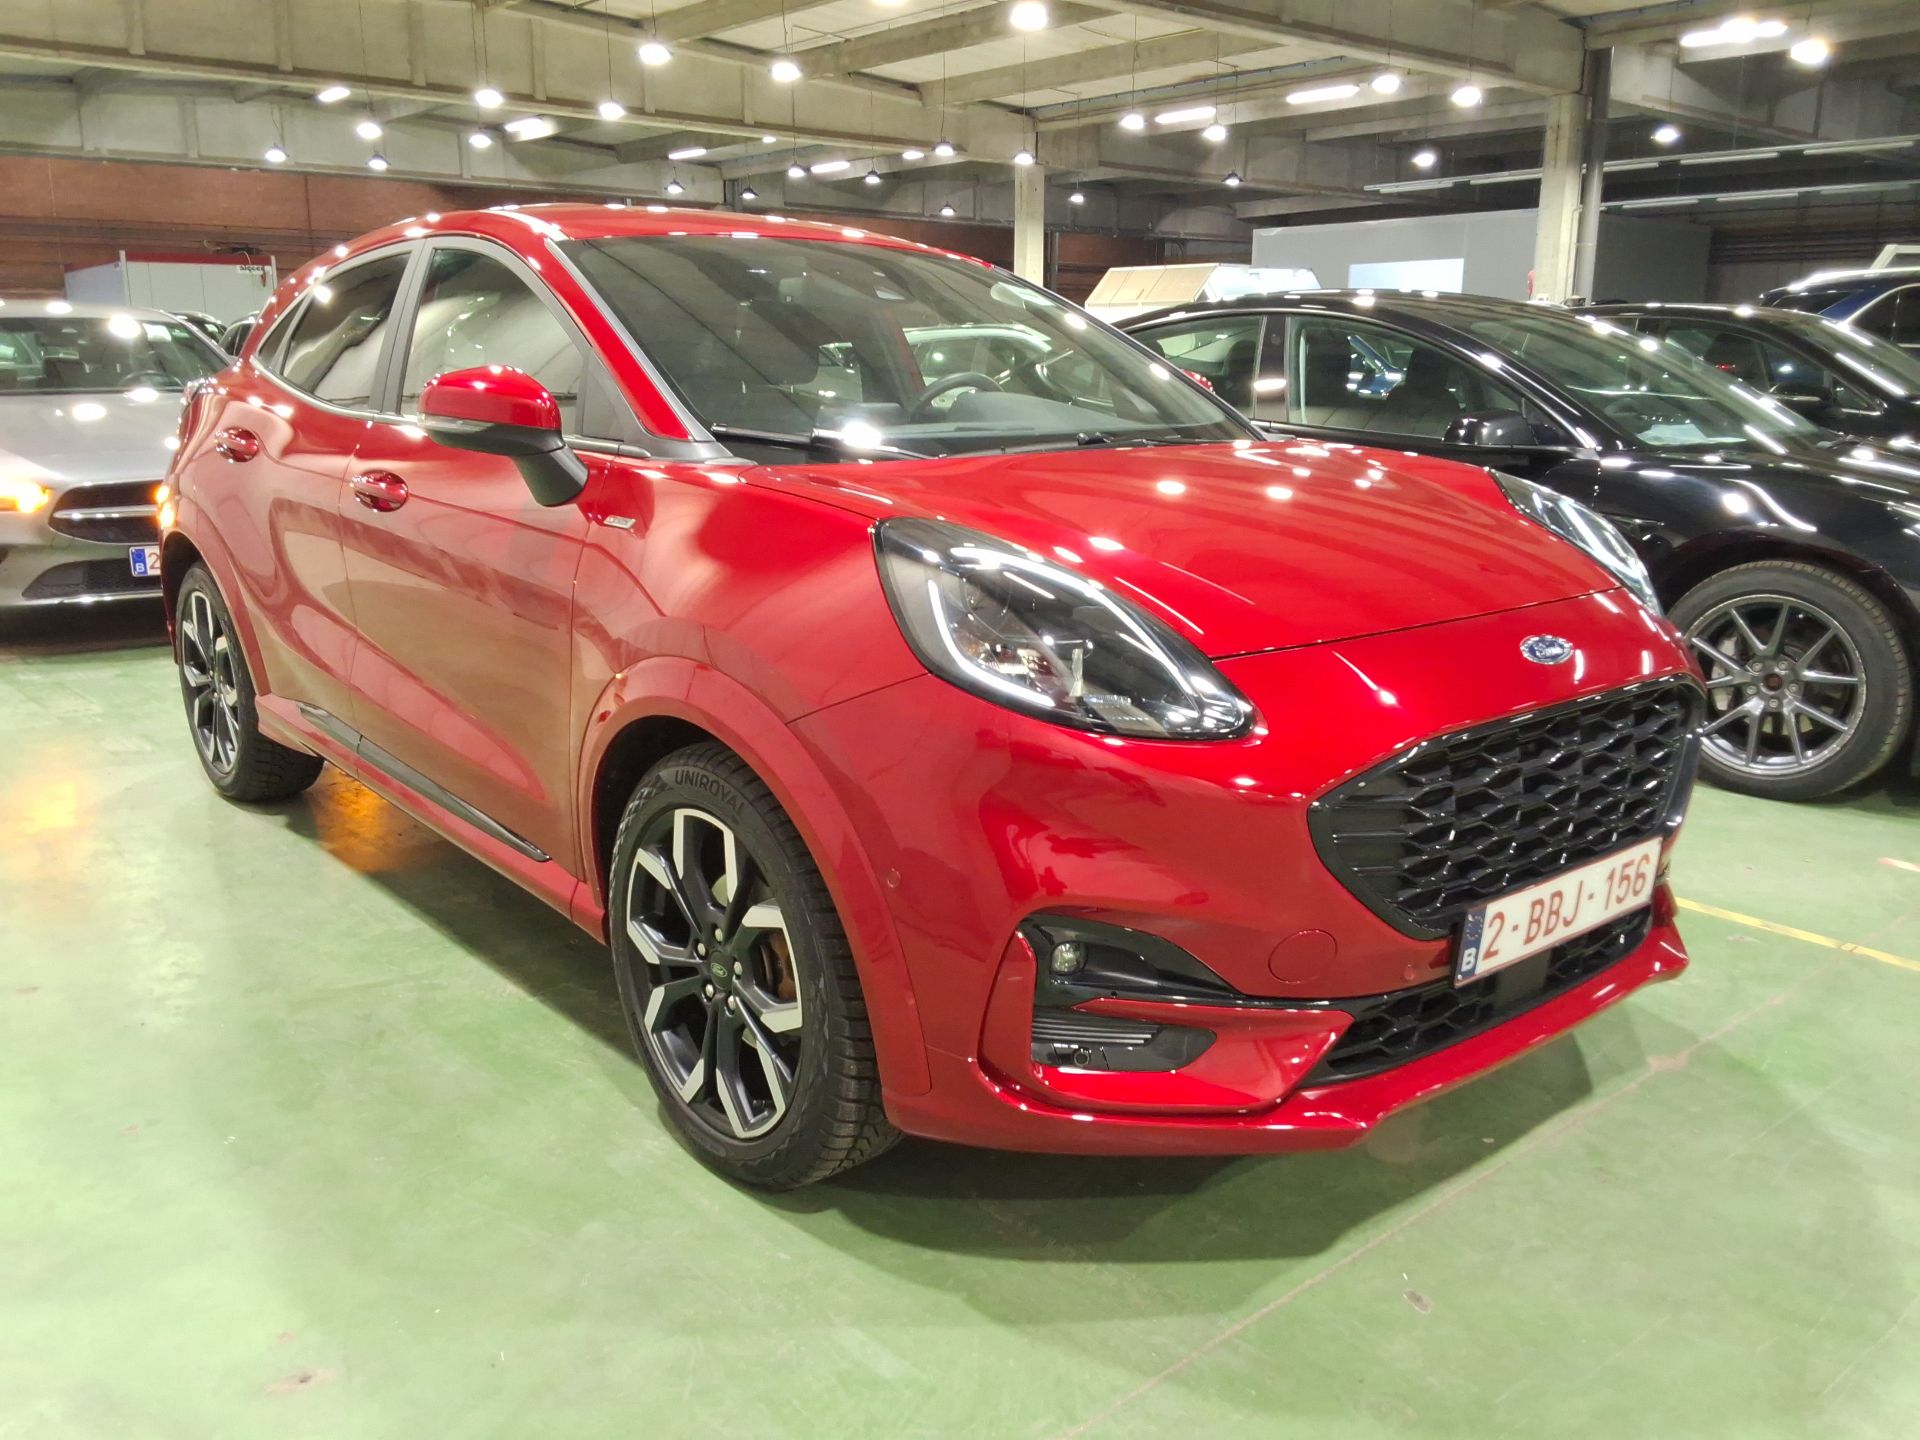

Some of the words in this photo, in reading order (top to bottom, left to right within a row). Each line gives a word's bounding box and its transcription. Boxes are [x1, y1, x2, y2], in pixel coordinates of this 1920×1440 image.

[135, 562, 145, 573] B
[1482, 853, 1651, 962] 2-BBJ-156
[1460, 947, 1478, 973] B
